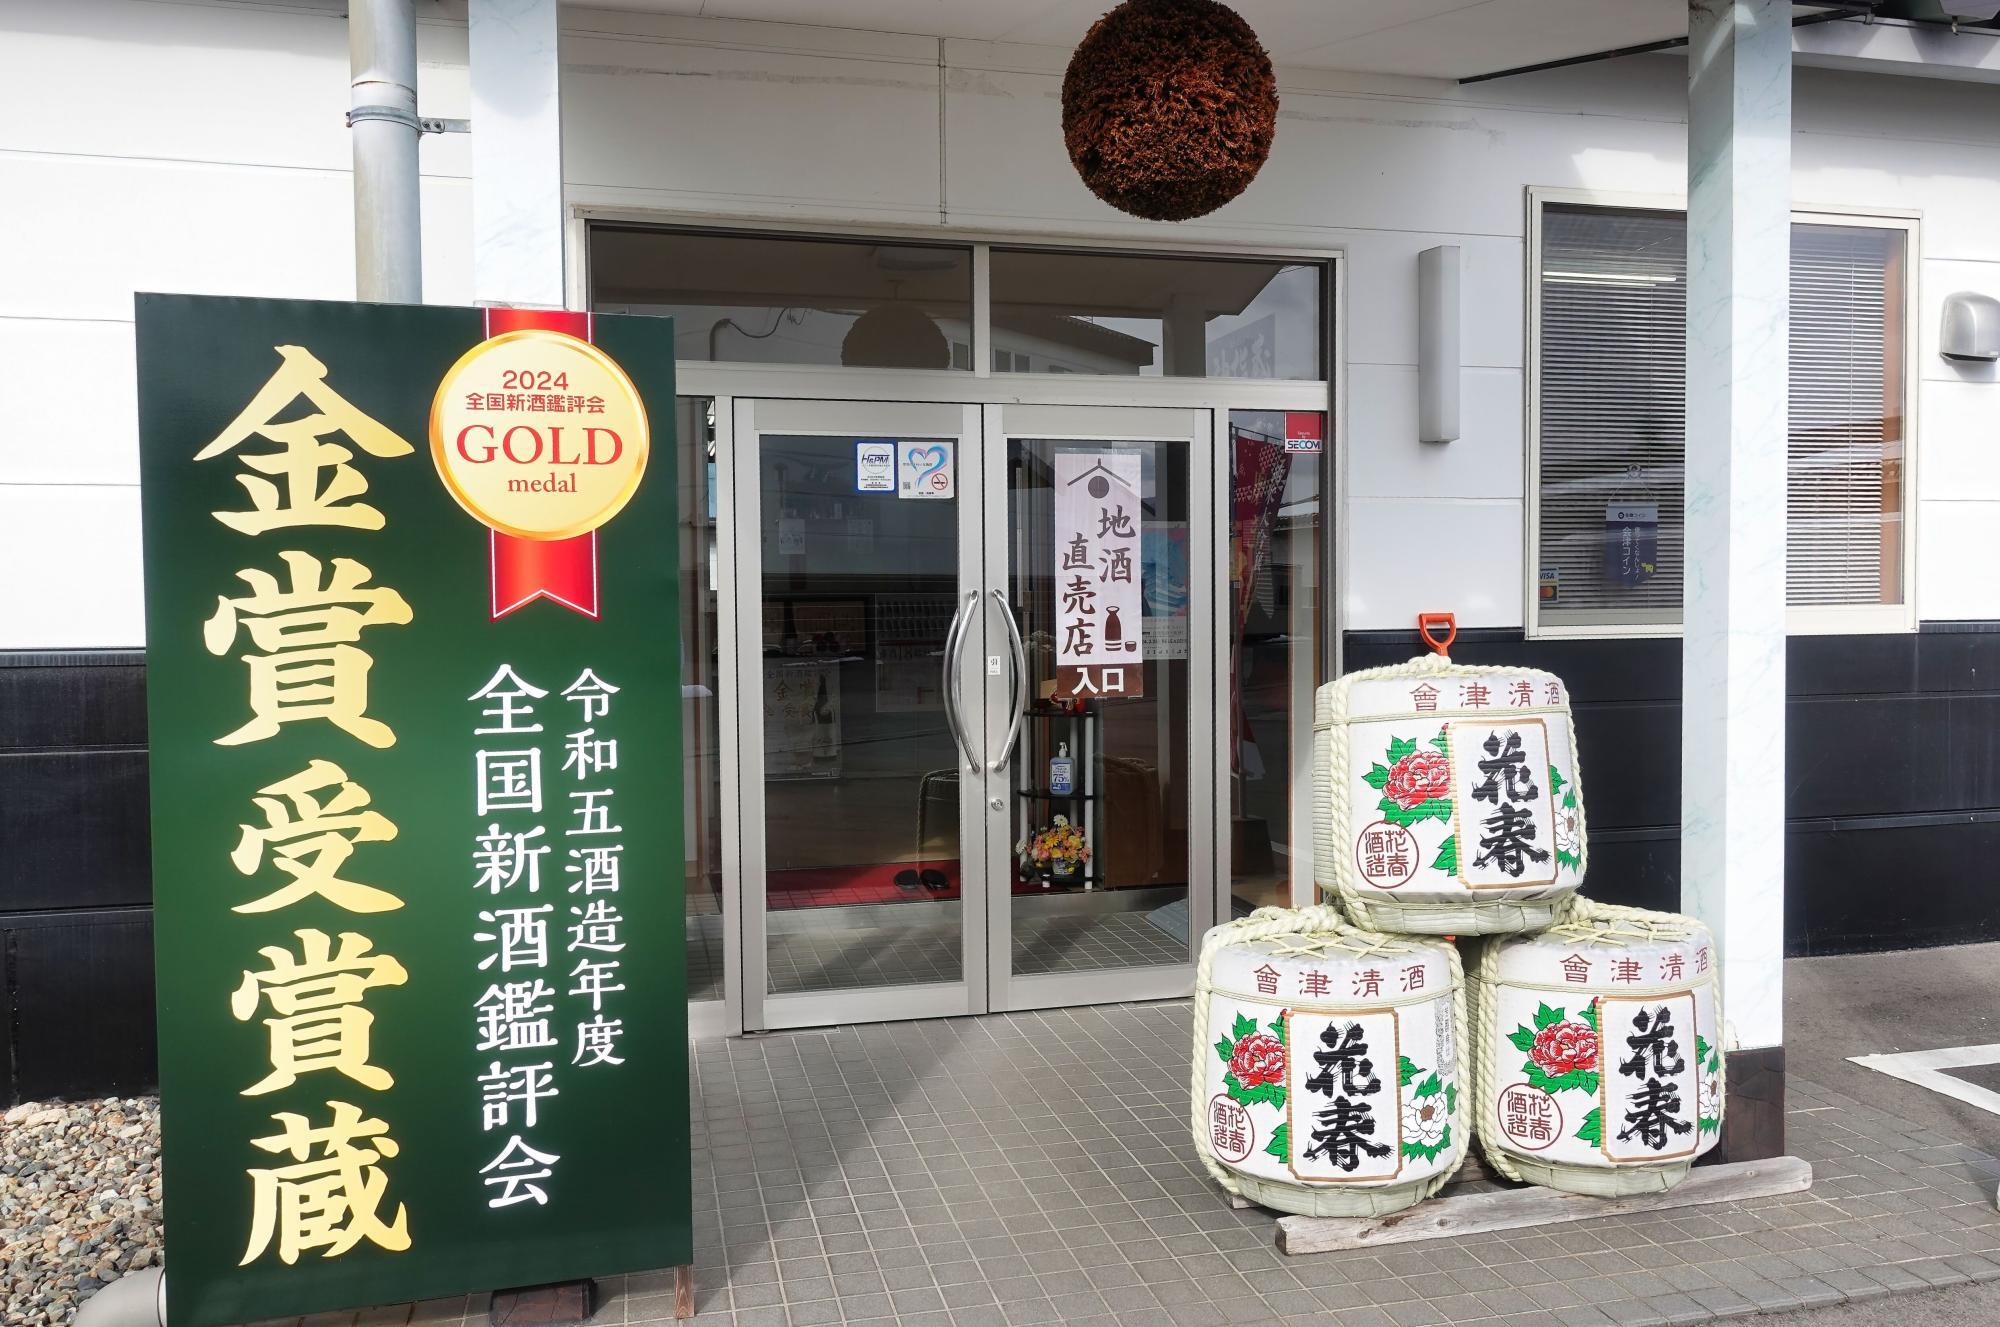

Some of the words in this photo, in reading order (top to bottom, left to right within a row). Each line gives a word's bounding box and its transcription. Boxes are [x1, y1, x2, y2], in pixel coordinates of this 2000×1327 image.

[502, 370, 569, 391] 2024
[465, 392, 606, 414] 全国新酒鑑評会
[456, 424, 624, 466] GOLD
[1287, 440, 1321, 450] SECOM
[507, 472, 578, 493] medal
[1096, 504, 1136, 584] 地酒
[1062, 531, 1097, 657] 直売店
[1071, 667, 1125, 695] 入口
[1409, 680, 1560, 712] 會津清酒
[193, 343, 415, 1266] 金賞受賞蔵
[1471, 730, 1552, 878] 花春
[559, 667, 627, 1068] 令和五酒造年度
[466, 663, 561, 1209] 全国新酒鑑評会
[1253, 963, 1426, 998] 會津清酒
[1559, 947, 1708, 984] 會津清酒
[1303, 1019, 1395, 1172] 花春
[1616, 1005, 1694, 1150] 花春
